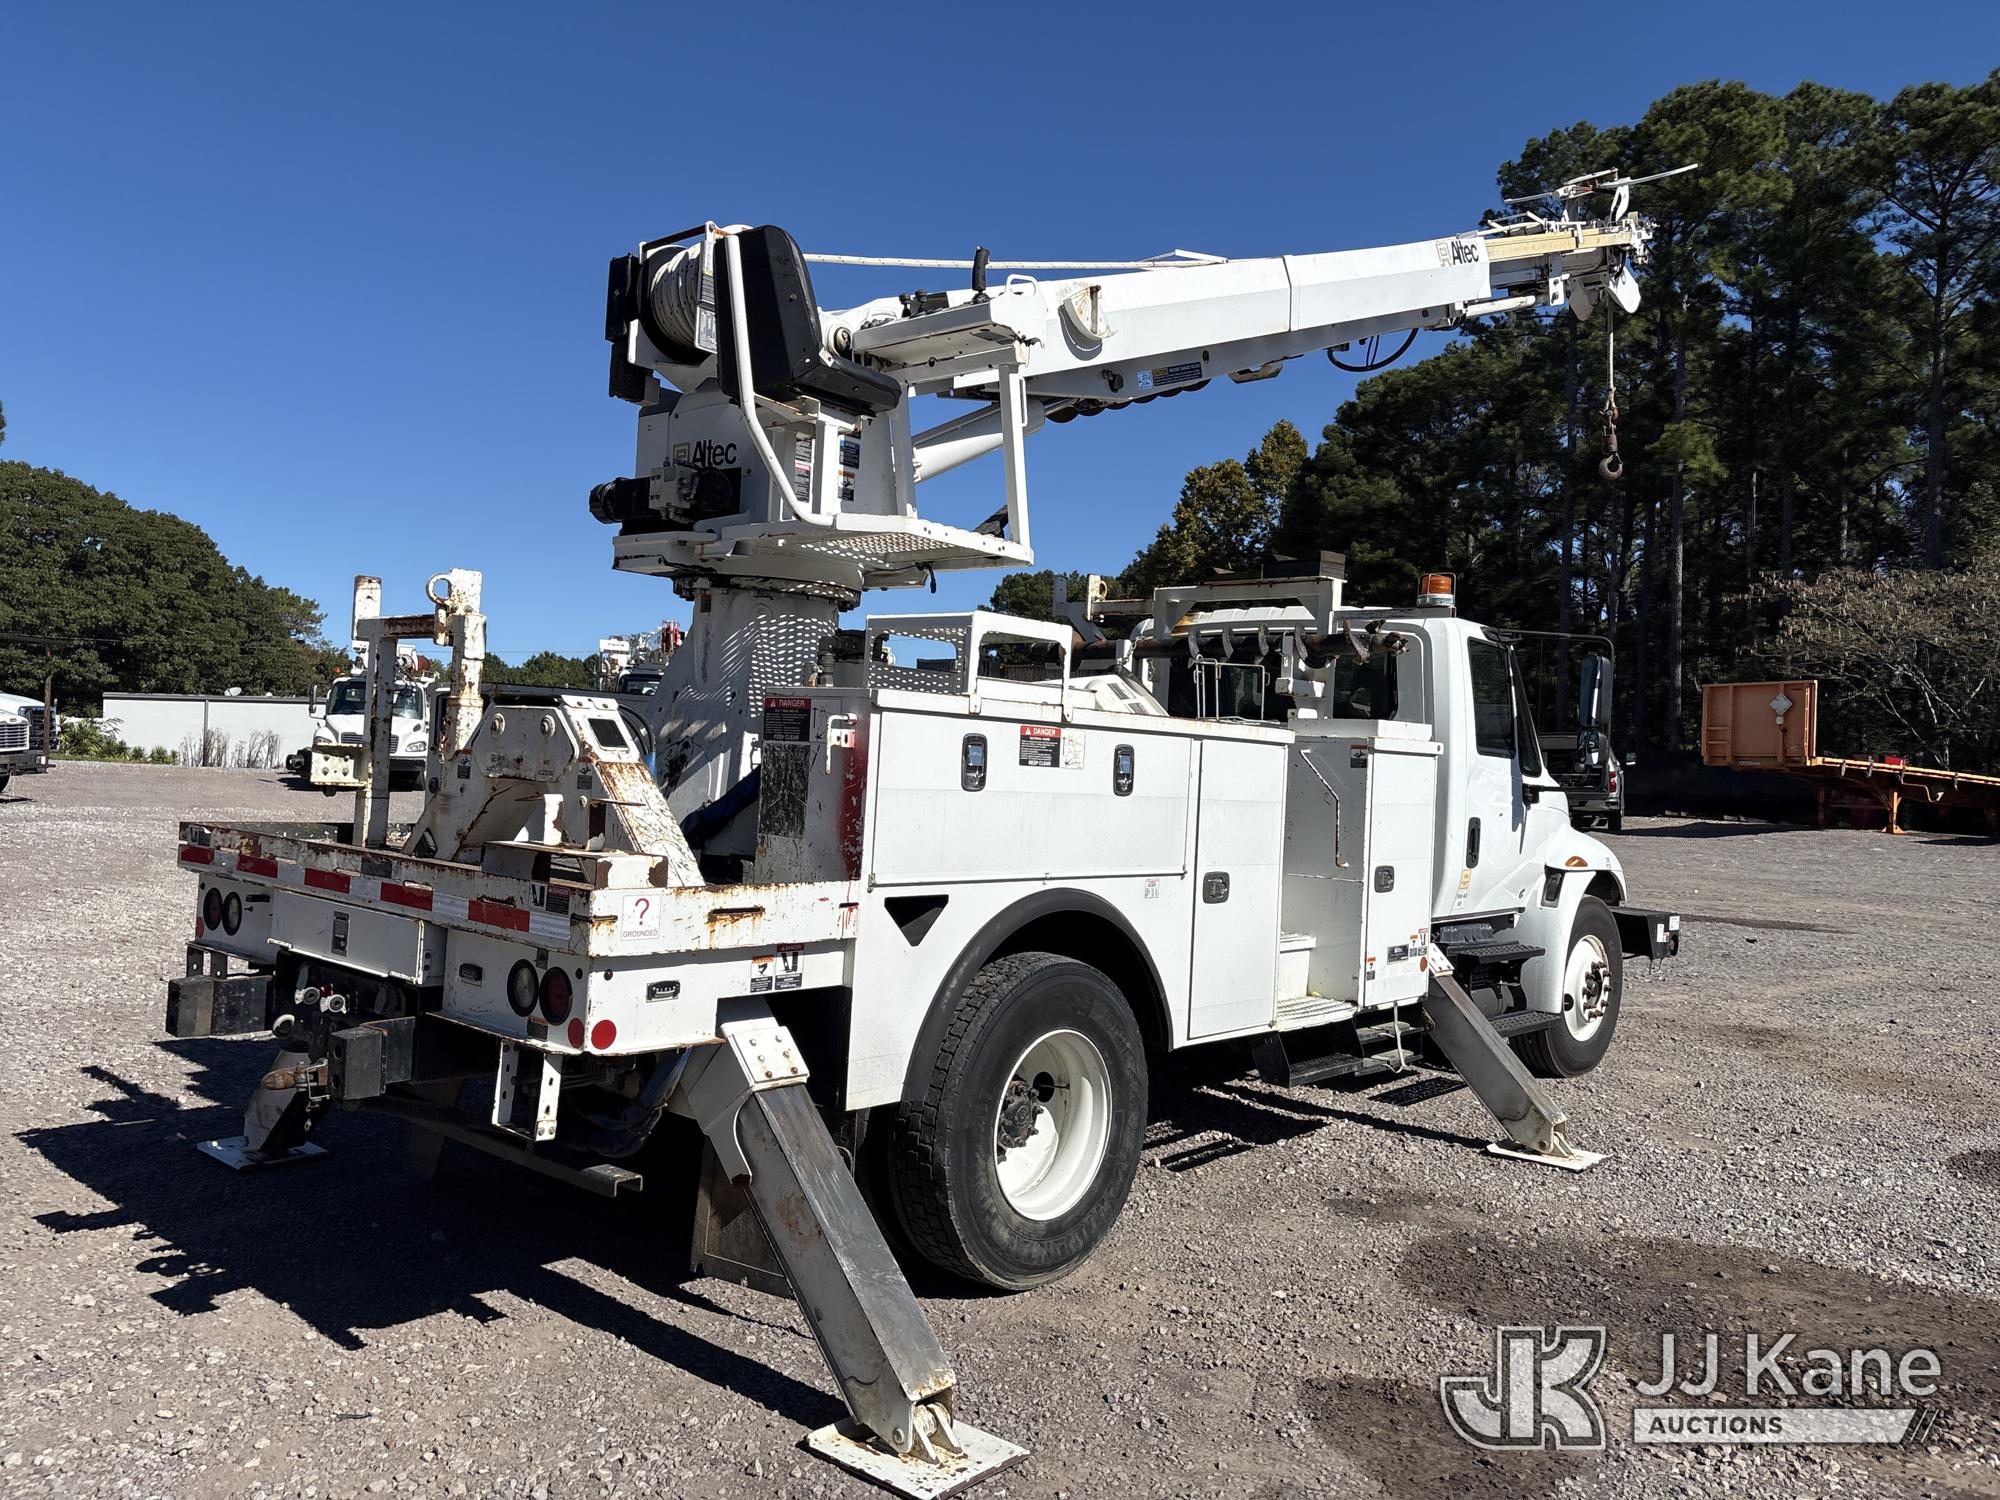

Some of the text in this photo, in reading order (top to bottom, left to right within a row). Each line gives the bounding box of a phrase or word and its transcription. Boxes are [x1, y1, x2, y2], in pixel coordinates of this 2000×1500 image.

[1451, 240, 1479, 266] Altec
[691, 439, 738, 467] Altec
[779, 699, 805, 707] DANGER
[1033, 727, 1056, 736] DANGER
[622, 929, 658, 938] GROUNDED
